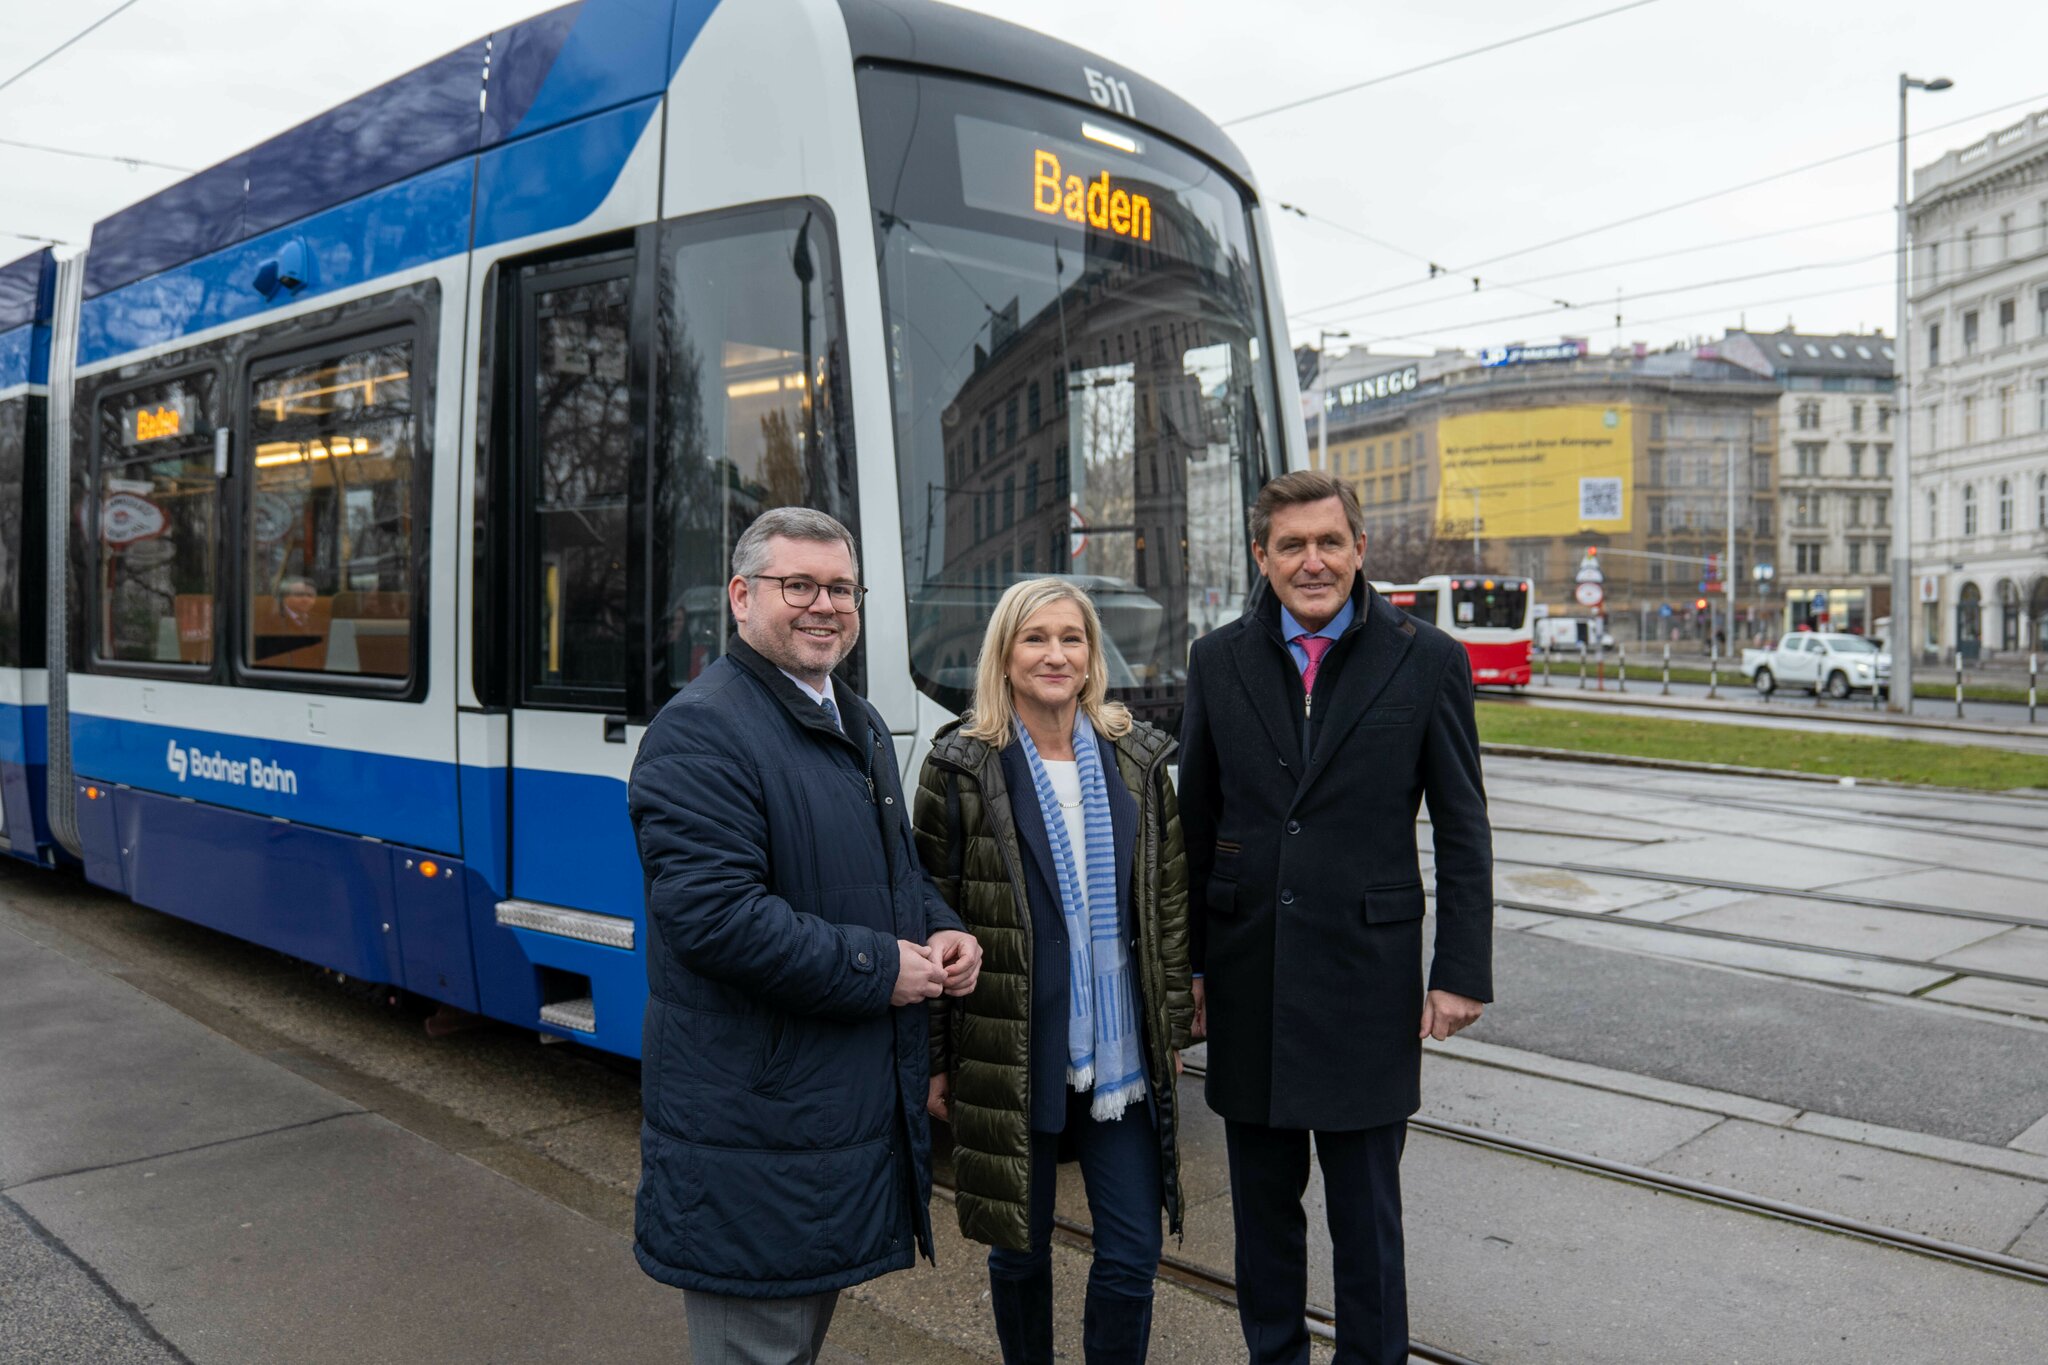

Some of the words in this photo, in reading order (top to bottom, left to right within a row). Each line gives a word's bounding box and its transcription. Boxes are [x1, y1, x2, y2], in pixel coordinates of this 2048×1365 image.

[1083, 66, 1136, 119] 511
[1034, 149, 1151, 241] Baden
[1339, 367, 1417, 407] WINEGG
[190, 747, 248, 785] Badner
[250, 757, 298, 795] Bahn
